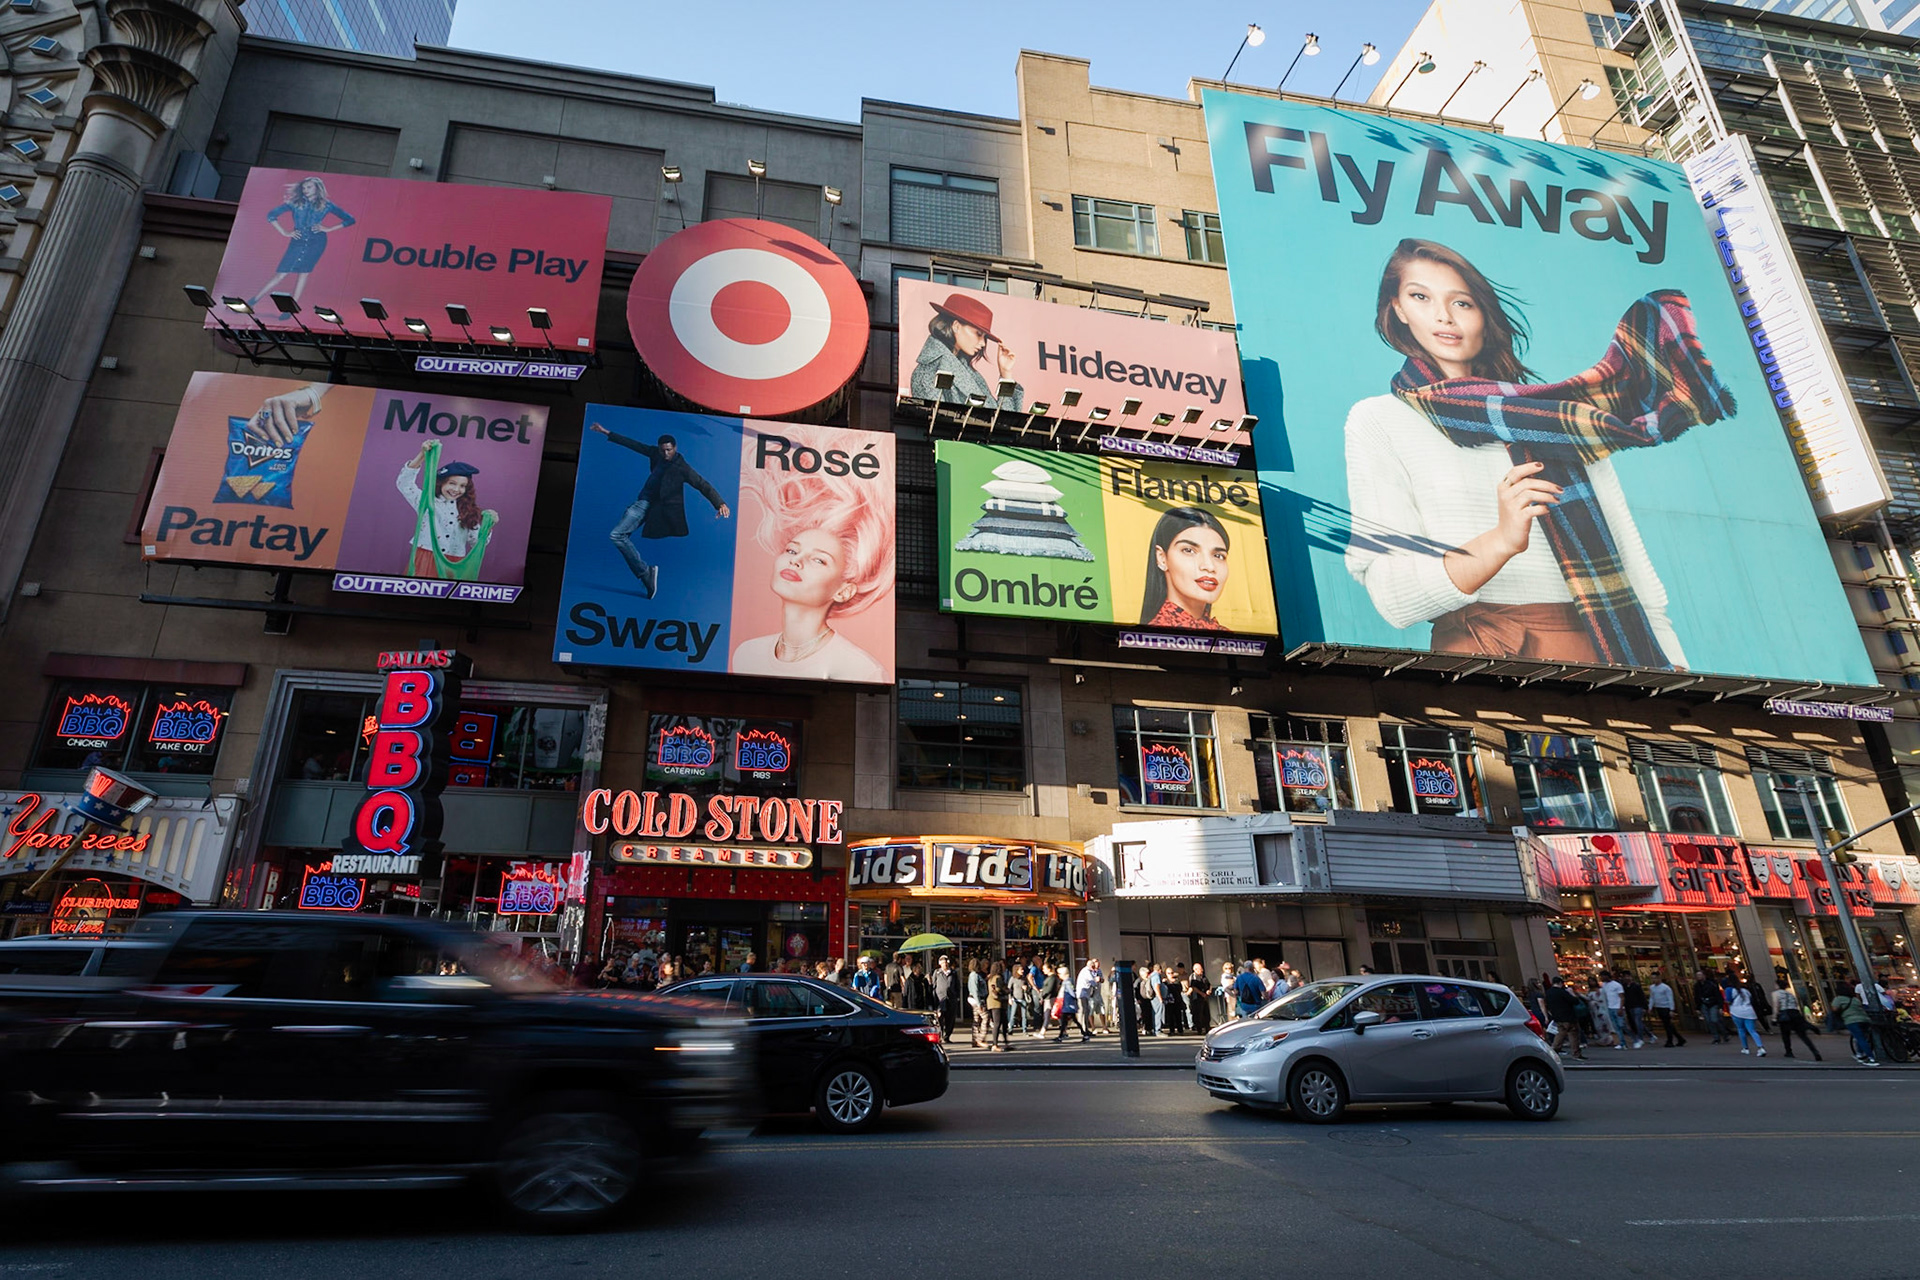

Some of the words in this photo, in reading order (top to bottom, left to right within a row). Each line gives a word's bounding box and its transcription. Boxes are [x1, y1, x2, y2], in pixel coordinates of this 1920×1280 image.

[1243, 120, 1394, 225] Fly
[1415, 148, 1669, 265] Away
[362, 238, 497, 272] Double
[508, 248, 588, 283] Play
[421, 357, 522, 376] OUTFRONT
[528, 362, 580, 379] PRIME
[1038, 340, 1227, 404] Hideaway
[383, 398, 533, 444] Monet
[231, 442, 293, 459] Doritos
[755, 433, 881, 480] Rosé
[1103, 436, 1186, 459] OUTFRONT
[1195, 449, 1237, 465] PRIME
[1110, 466, 1251, 508] Flambé
[155, 505, 329, 561] Partay
[339, 576, 454, 597] OUTFRONT
[460, 583, 515, 602] PRIME
[955, 567, 1099, 611] Ombré
[565, 602, 721, 663] Sway
[1123, 633, 1210, 652] OUTFRONT
[1217, 640, 1262, 655] PRIME
[377, 650, 450, 668] DALLAS
[73, 706, 121, 717] DALLAS
[165, 711, 212, 721] DALLAS
[1775, 700, 1849, 718] OUTFRONT
[1854, 706, 1892, 721] PRIME
[62, 714, 123, 737] BBQ
[155, 718, 213, 740] BBQ
[67, 738, 108, 748] CHICKEN
[183, 743, 205, 752] OUT
[667, 737, 707, 747] DALLAS
[743, 742, 783, 750] DALLAS
[355, 670, 435, 856] BBQ
[661, 745, 712, 765] BBQ
[738, 750, 787, 770] BBQ
[1149, 755, 1184, 765] DALLAS
[1285, 761, 1319, 769] DALLAS
[664, 767, 706, 776] CATERING
[753, 771, 771, 779] RIBS
[1145, 760, 1192, 783] BBQ
[1282, 765, 1327, 788] BBQ
[1414, 769, 1449, 778] DALLAS
[1153, 783, 1186, 792] BURGERS
[1295, 788, 1318, 797] STEAK
[1414, 775, 1458, 797] BBQ
[583, 788, 697, 838] COLD
[704, 795, 843, 844] STONE
[621, 844, 800, 864] CREAMERY
[1578, 853, 1622, 871] NY
[1697, 845, 1738, 866] NY
[331, 855, 421, 875] RESTAURANT
[850, 848, 917, 885] Lids
[939, 847, 1031, 885] Lids
[310, 876, 356, 885] DALLAS
[1581, 872, 1627, 884] GIFTS
[1669, 867, 1747, 895] GIFTS
[60, 897, 140, 909] CLUBHOUSE
[301, 885, 360, 908] BBQ
[501, 891, 555, 912] BBQ
